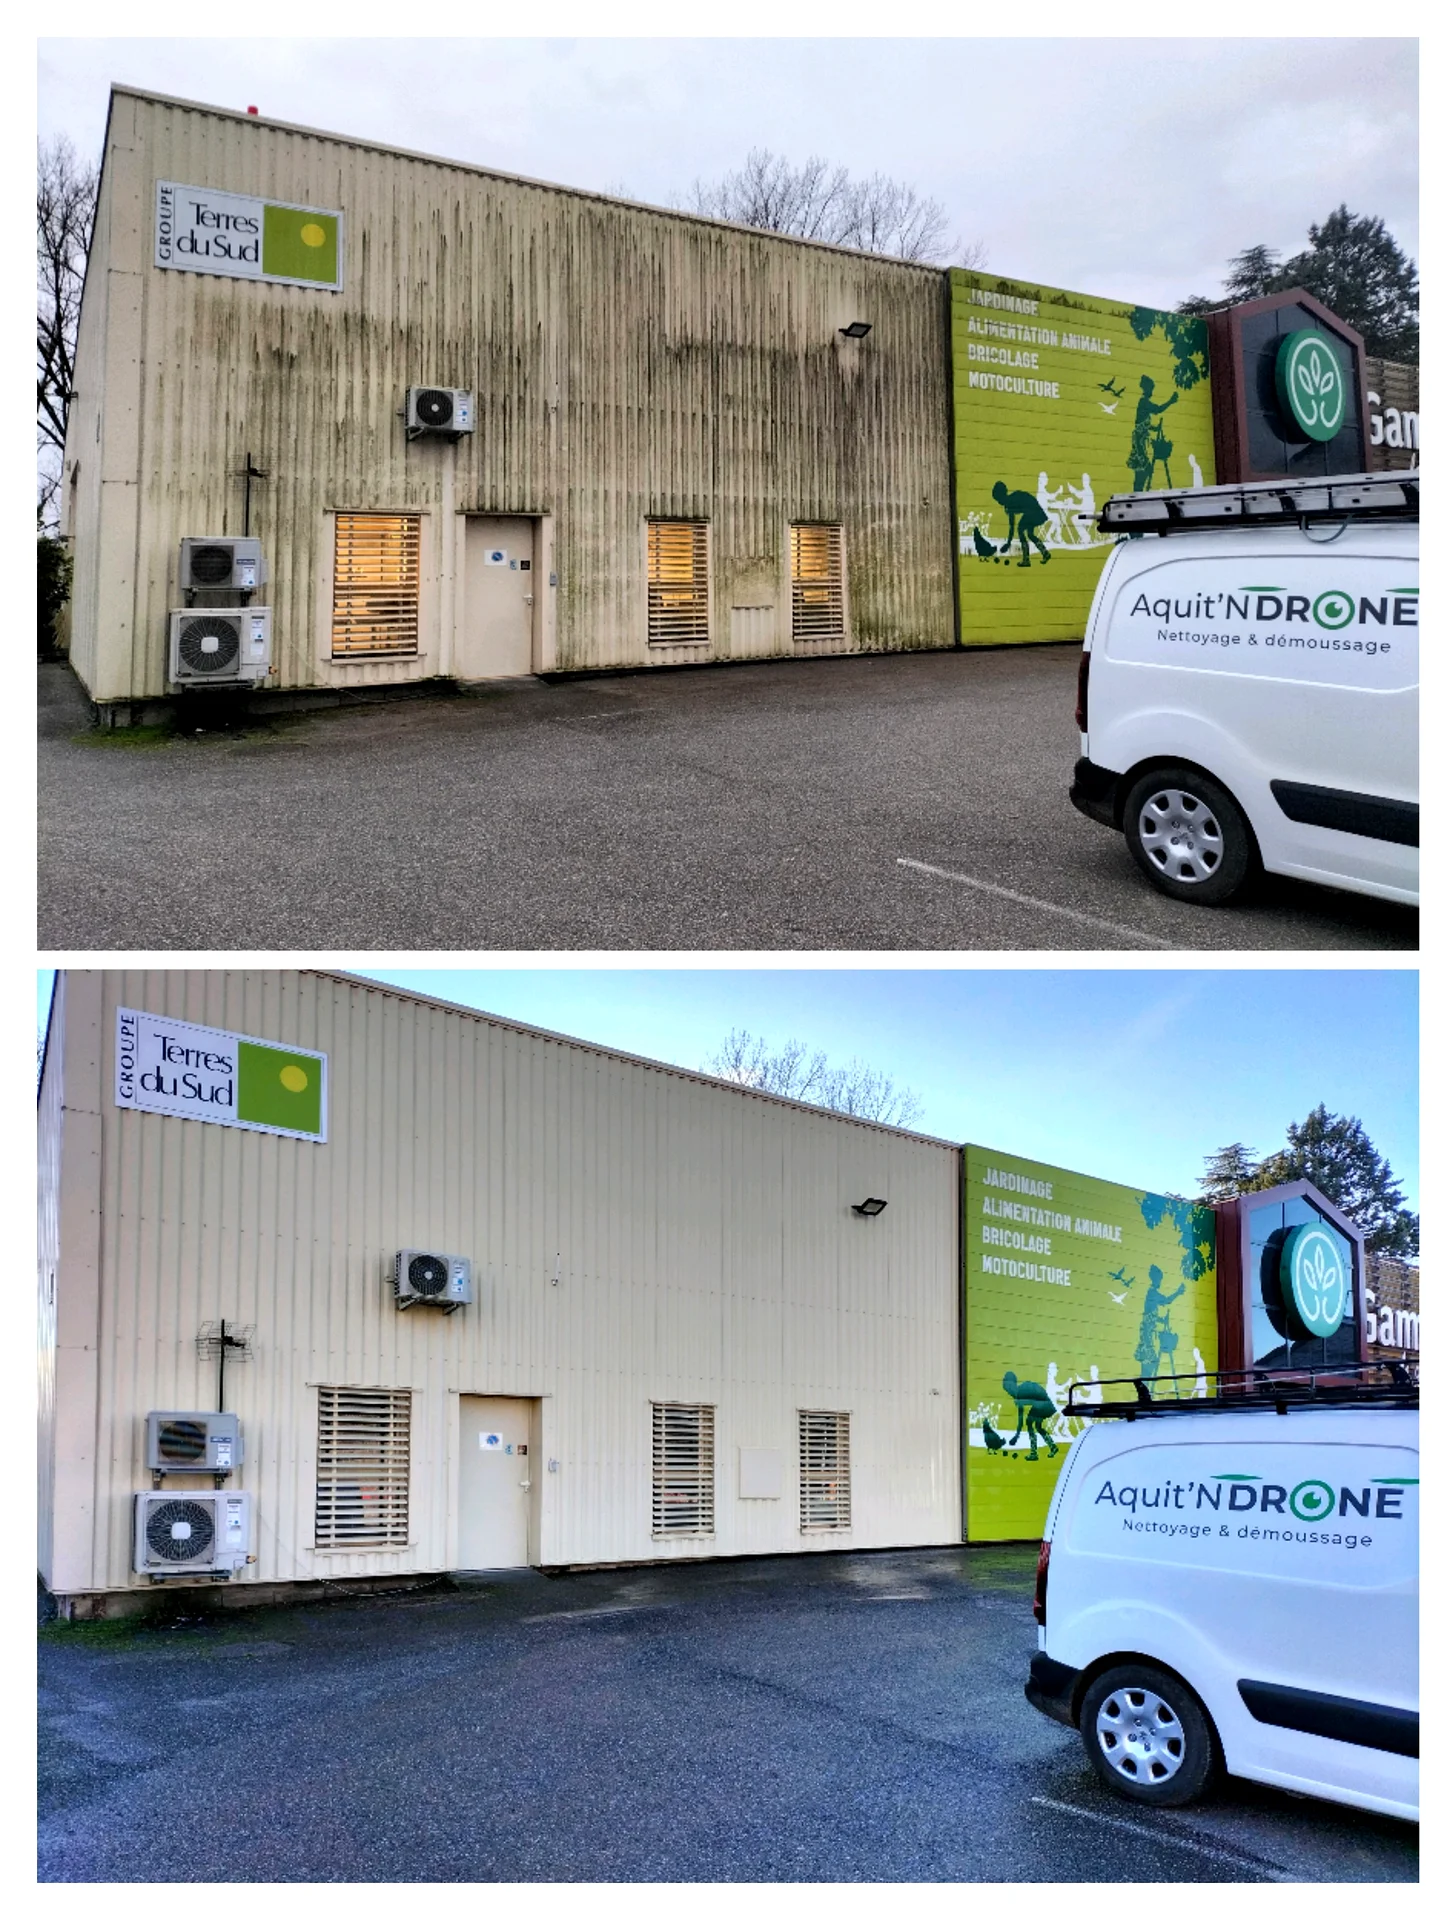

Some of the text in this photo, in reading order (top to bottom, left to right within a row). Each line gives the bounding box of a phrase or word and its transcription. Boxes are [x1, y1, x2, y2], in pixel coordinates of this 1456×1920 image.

[159, 186, 173, 260] GROUPE
[188, 201, 259, 234] Terres
[176, 229, 259, 263] du Sud
[967, 288, 1039, 317] JARDINAGE
[968, 316, 1112, 356] ALIMENTATION ANIMALE
[968, 343, 1039, 370] BRICOLAGE
[968, 371, 1060, 399] MOTOCULTURE
[1157, 629, 1391, 655] Nettoyage & démoussage
[119, 1015, 135, 1099] GROUPE
[153, 1033, 233, 1074] Terres
[140, 1065, 233, 1107] du Sud
[982, 1167, 1053, 1201] JARDINAGE
[983, 1196, 1122, 1243] ALIMENTATION ANIMALE
[982, 1225, 1052, 1255] BRICOLAGE
[982, 1255, 1071, 1287] MOTOCULTURE
[1122, 1518, 1373, 1548] Nettoyage & démoussage
